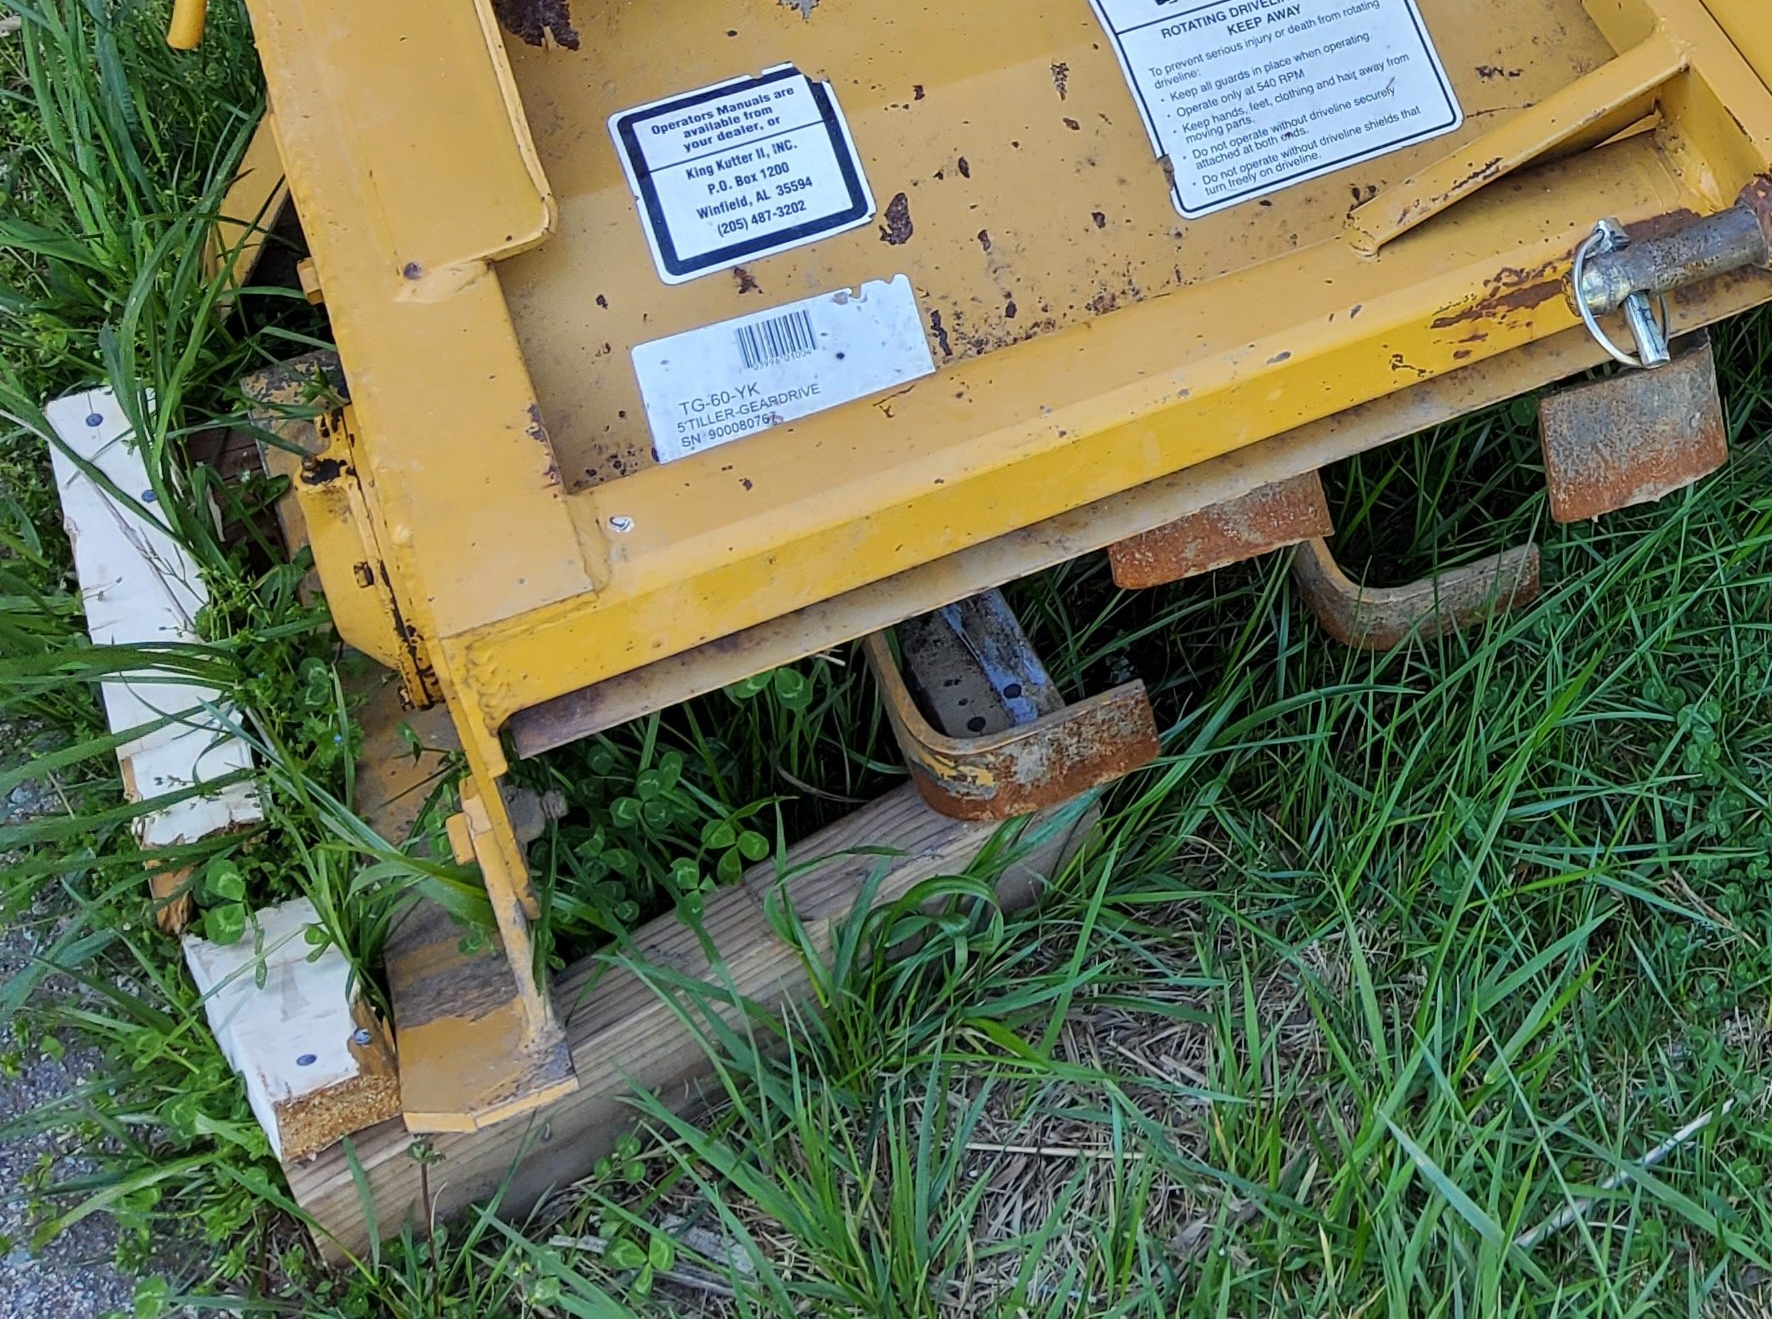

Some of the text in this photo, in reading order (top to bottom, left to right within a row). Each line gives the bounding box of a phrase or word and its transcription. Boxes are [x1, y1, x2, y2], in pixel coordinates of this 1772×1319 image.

[1148, 0, 1380, 78] To prevent serious injury or death from rotating
[1161, 11, 1226, 39] ROTATING
[1226, 4, 1301, 36] KEEP AWAY
[1154, 69, 1202, 90] driveline:
[1170, 86, 1198, 102] Keep
[1200, 81, 1212, 92] all
[1215, 70, 1250, 89] guards
[1252, 67, 1262, 76] in
[1264, 57, 1291, 74] place
[1293, 47, 1321, 63] when
[1176, 68, 1305, 117] Operate only at 540 RPM
[1182, 54, 1410, 133] Keep hands, feet, clothing and hair away from
[651, 87, 794, 135] Operators Manuals are
[683, 106, 773, 139] available from
[1186, 115, 1255, 144] moving parts.
[1192, 86, 1395, 159] Do not operate without driveline securely
[683, 115, 781, 153] your dealer, or
[1196, 148, 1240, 170] attached
[1242, 144, 1254, 154] at
[1255, 135, 1279, 150] both
[1202, 105, 1421, 185] Do not operate without driveline shields that
[685, 165, 714, 180] King
[716, 151, 753, 171] Kutter
[771, 139, 798, 154] INC.
[707, 161, 790, 195] P.O. Box 1200
[1205, 152, 1322, 196] turn freely on driveline.
[696, 176, 813, 220] Winfield, AL 35594
[717, 199, 806, 237] (205) 487-3202
[678, 382, 760, 416] TG-60-YK
[681, 433, 701, 448] SN
